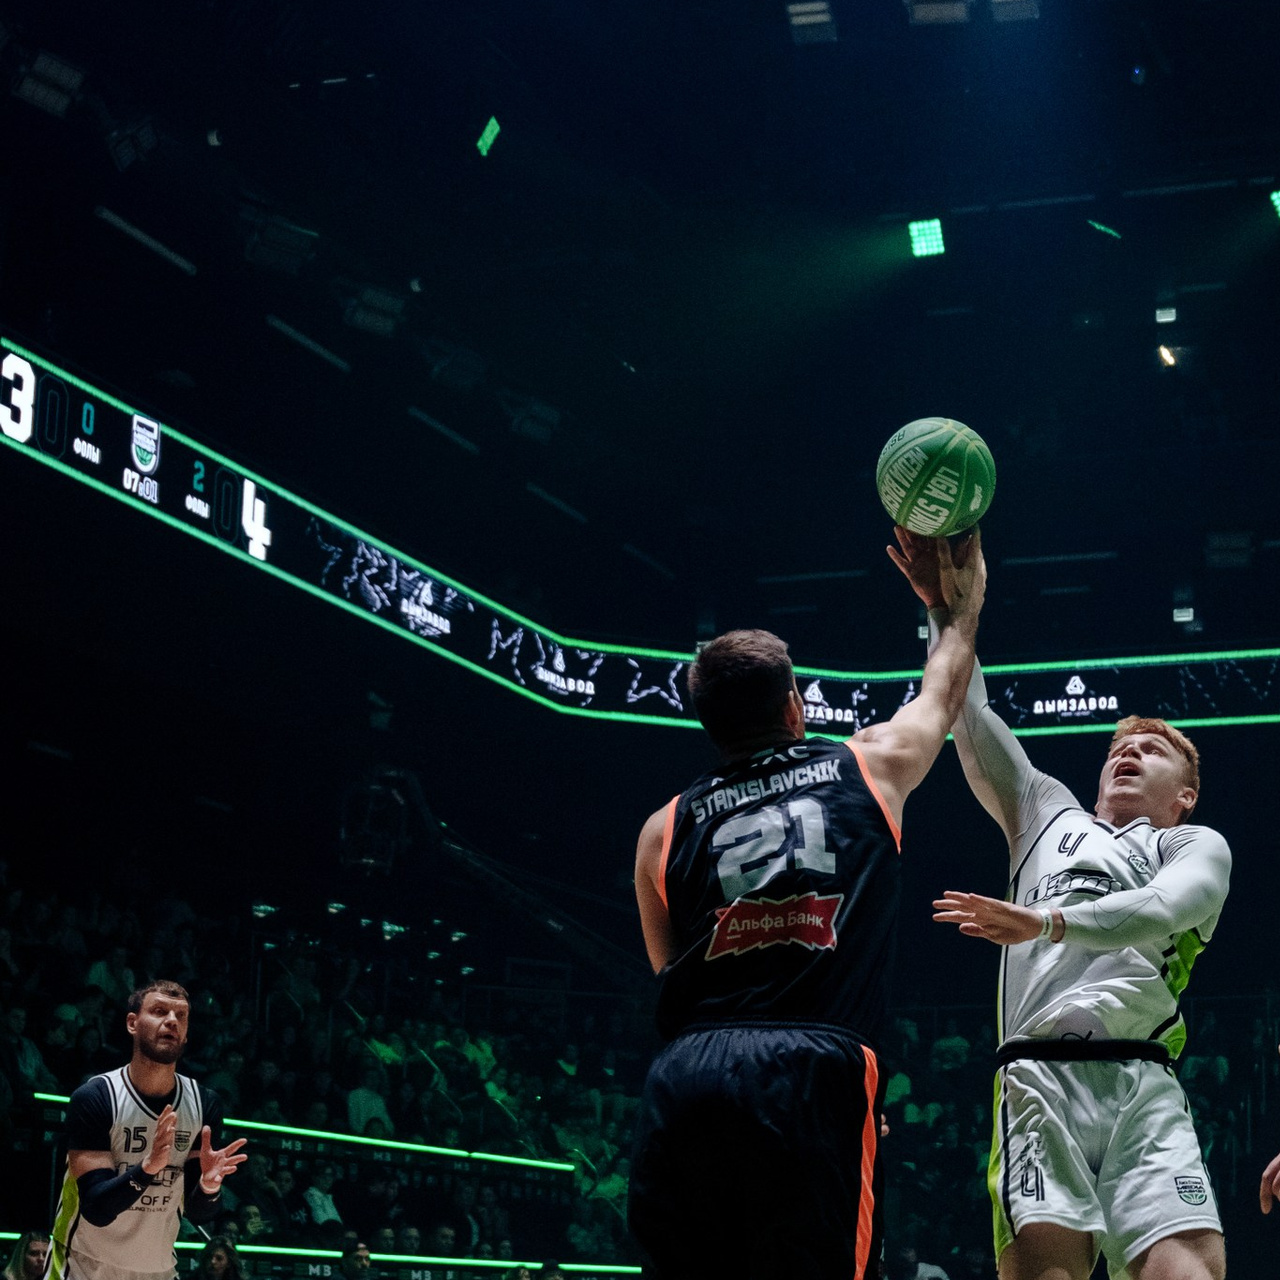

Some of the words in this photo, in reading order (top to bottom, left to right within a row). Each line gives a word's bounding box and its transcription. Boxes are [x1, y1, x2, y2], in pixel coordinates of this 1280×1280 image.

[0, 353, 36, 443] 3
[82, 402, 95, 435] 0
[73, 437, 101, 465] ФОЛЫ
[122, 468, 160, 504] 07:01
[193, 461, 206, 493] 2
[923, 465, 961, 504] LIGA
[185, 495, 210, 520] ФОЛЫ
[241, 478, 272, 561] 4
[803, 705, 855, 723] ЗАВОД
[1032, 695, 1120, 714] ДЫМЗАВОД
[691, 759, 842, 824] STANISLAVCHIK
[712, 798, 836, 902] 21
[1058, 832, 1089, 858] 4
[727, 913, 785, 934] Альфа
[787, 910, 825, 929] Банк
[124, 1127, 147, 1153] 15
[1021, 1167, 1045, 1201] 4
[141, 1195, 160, 1206] OF
